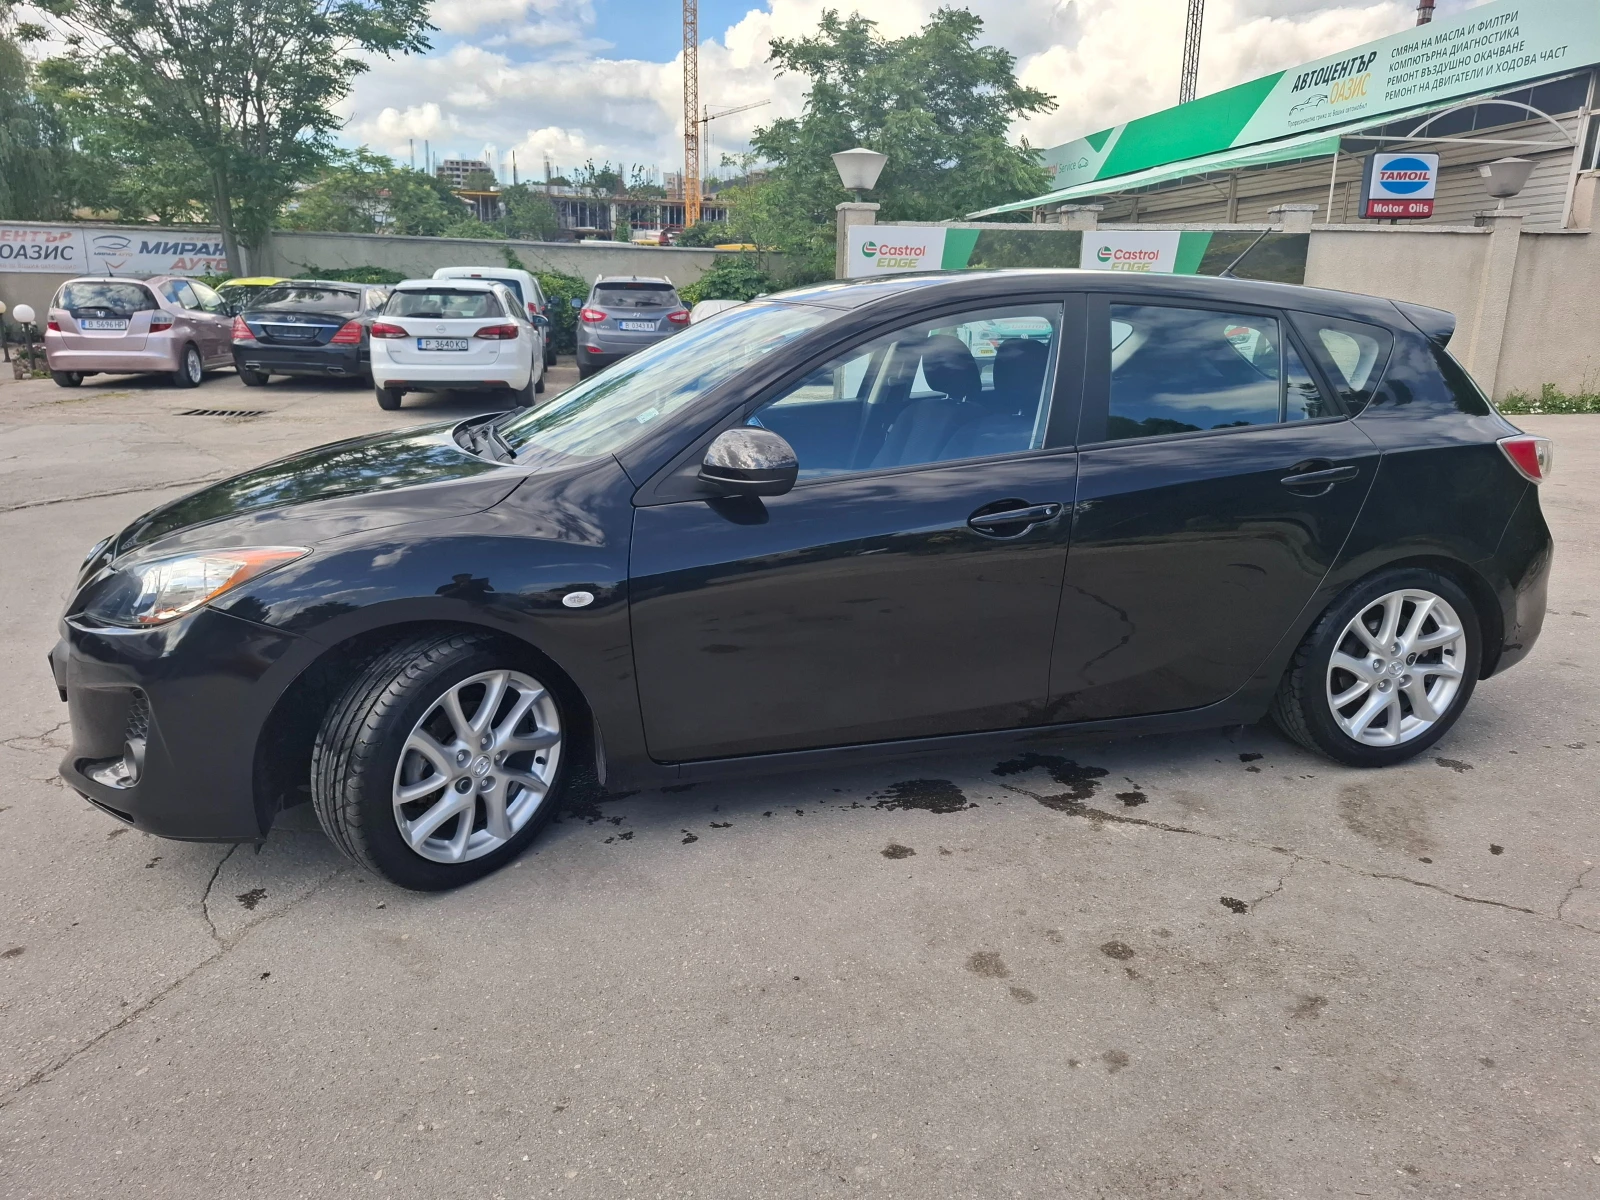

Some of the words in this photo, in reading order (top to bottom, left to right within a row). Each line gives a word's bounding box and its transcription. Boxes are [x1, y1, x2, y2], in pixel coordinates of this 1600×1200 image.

[1391, 42, 1419, 58] СМЯНА
[1421, 37, 1433, 49] НА
[1434, 27, 1465, 45] МАСЛА
[1467, 24, 1476, 35] И
[1477, 10, 1519, 31] ФИЛТРИ
[1389, 47, 1447, 72] КОМПЮТЪРНА
[1448, 26, 1519, 58] ДИАГНОСТИКА
[1386, 69, 1419, 87] РЕМОНТ
[1420, 55, 1471, 78] ВЪЗДУШНО
[1473, 40, 1525, 63] ОКАЧВАНЕ
[1291, 51, 1377, 93] АВТОЦЕНТЪР
[1384, 84, 1417, 101] РЕМОНТ
[1418, 81, 1430, 92] НА
[1431, 67, 1484, 92] ДВИГАТЕЛИ
[1485, 64, 1494, 76] И
[1495, 53, 1537, 73] ХОДОВА
[1539, 45, 1568, 61] ЧАСТ
[1330, 72, 1371, 104] ОАЗИС
[1380, 171, 1431, 180] TAMOIL
[1373, 203, 1404, 213] Motor
[1408, 203, 1429, 213] Oils
[0, 243, 74, 261] ОАЗИС
[879, 244, 926, 256] Castrol
[1114, 249, 1160, 260] Castrol
[876, 257, 919, 268] EDGE
[1110, 261, 1153, 271] EDGE
[434, 340, 453, 348] 3640
[455, 340, 467, 349] KC
